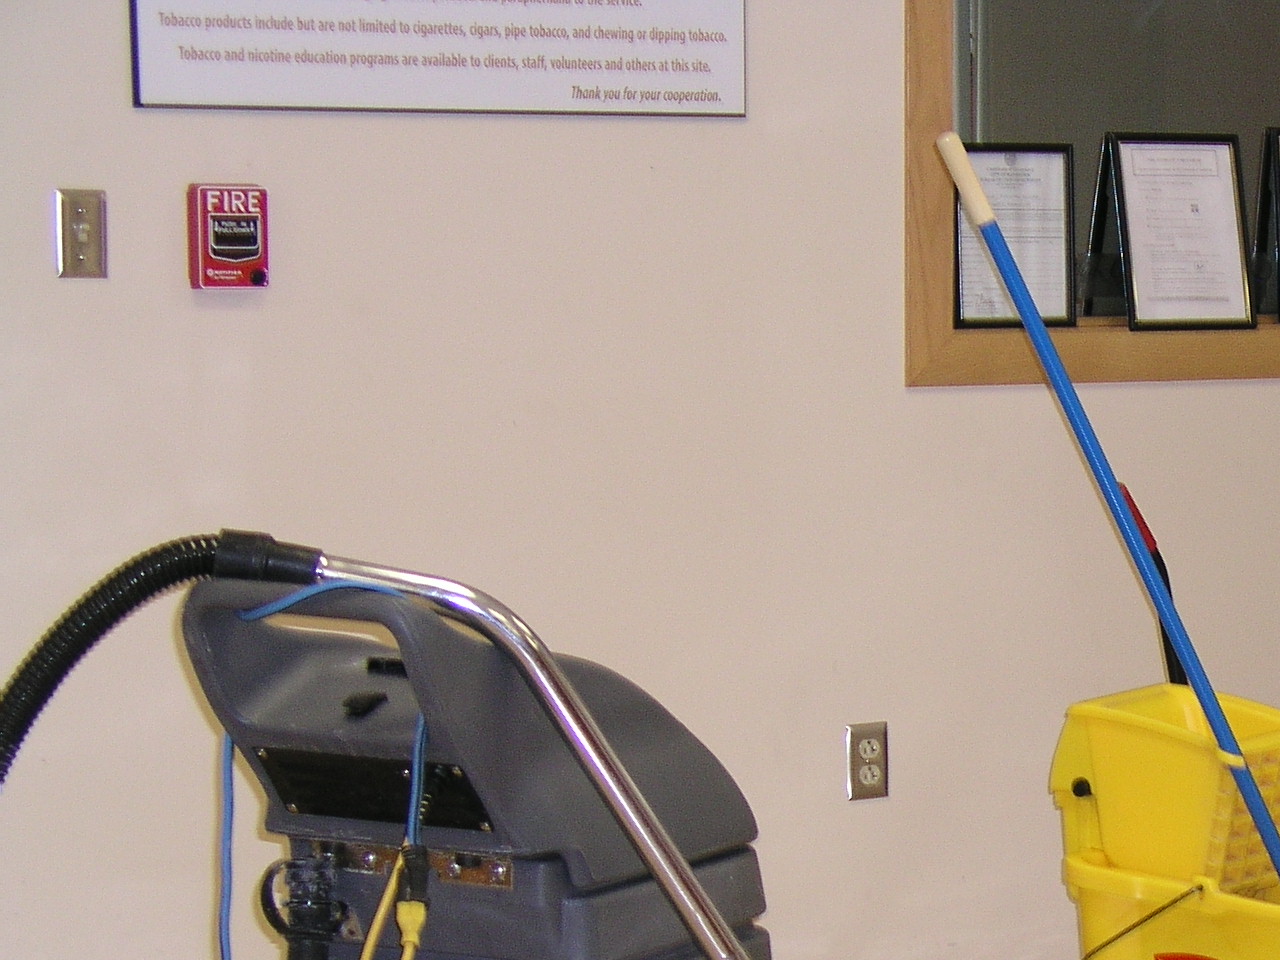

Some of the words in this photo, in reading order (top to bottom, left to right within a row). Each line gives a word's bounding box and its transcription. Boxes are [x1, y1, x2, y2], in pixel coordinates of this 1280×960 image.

[159, 12, 201, 27] Tobacco
[205, 13, 251, 30] products
[255, 15, 293, 30] include
[296, 16, 315, 31] but
[318, 20, 335, 31] are
[338, 19, 356, 32] not
[359, 19, 396, 34] limited
[399, 22, 410, 34] to
[413, 20, 466, 37] cigarettes,
[469, 22, 501, 39] cigars,
[505, 23, 526, 40] pipe
[529, 24, 569, 40] tobacco,
[572, 25, 591, 39] and
[593, 26, 634, 43] chewing
[636, 30, 646, 40] or
[649, 27, 686, 44] dipping
[688, 28, 727, 43] tobacco.
[178, 46, 221, 61] Tobacco
[224, 47, 245, 62] and
[248, 48, 291, 63] nicotine
[294, 50, 347, 65] education
[350, 54, 399, 69] programs
[402, 56, 418, 67] are
[421, 53, 467, 68] available
[471, 56, 481, 68] to
[483, 54, 519, 70] clients,
[521, 55, 547, 71] staff,
[551, 56, 601, 71] volunteers
[604, 58, 623, 71] and
[625, 58, 656, 72] others
[658, 60, 669, 72] at
[671, 59, 689, 72] this
[691, 60, 711, 73] site.
[571, 85, 601, 100] Thank
[603, 90, 621, 103] you
[622, 88, 637, 102] for
[639, 91, 660, 104] your
[663, 89, 722, 104] cooperation.
[206, 191, 261, 213] FIRE
